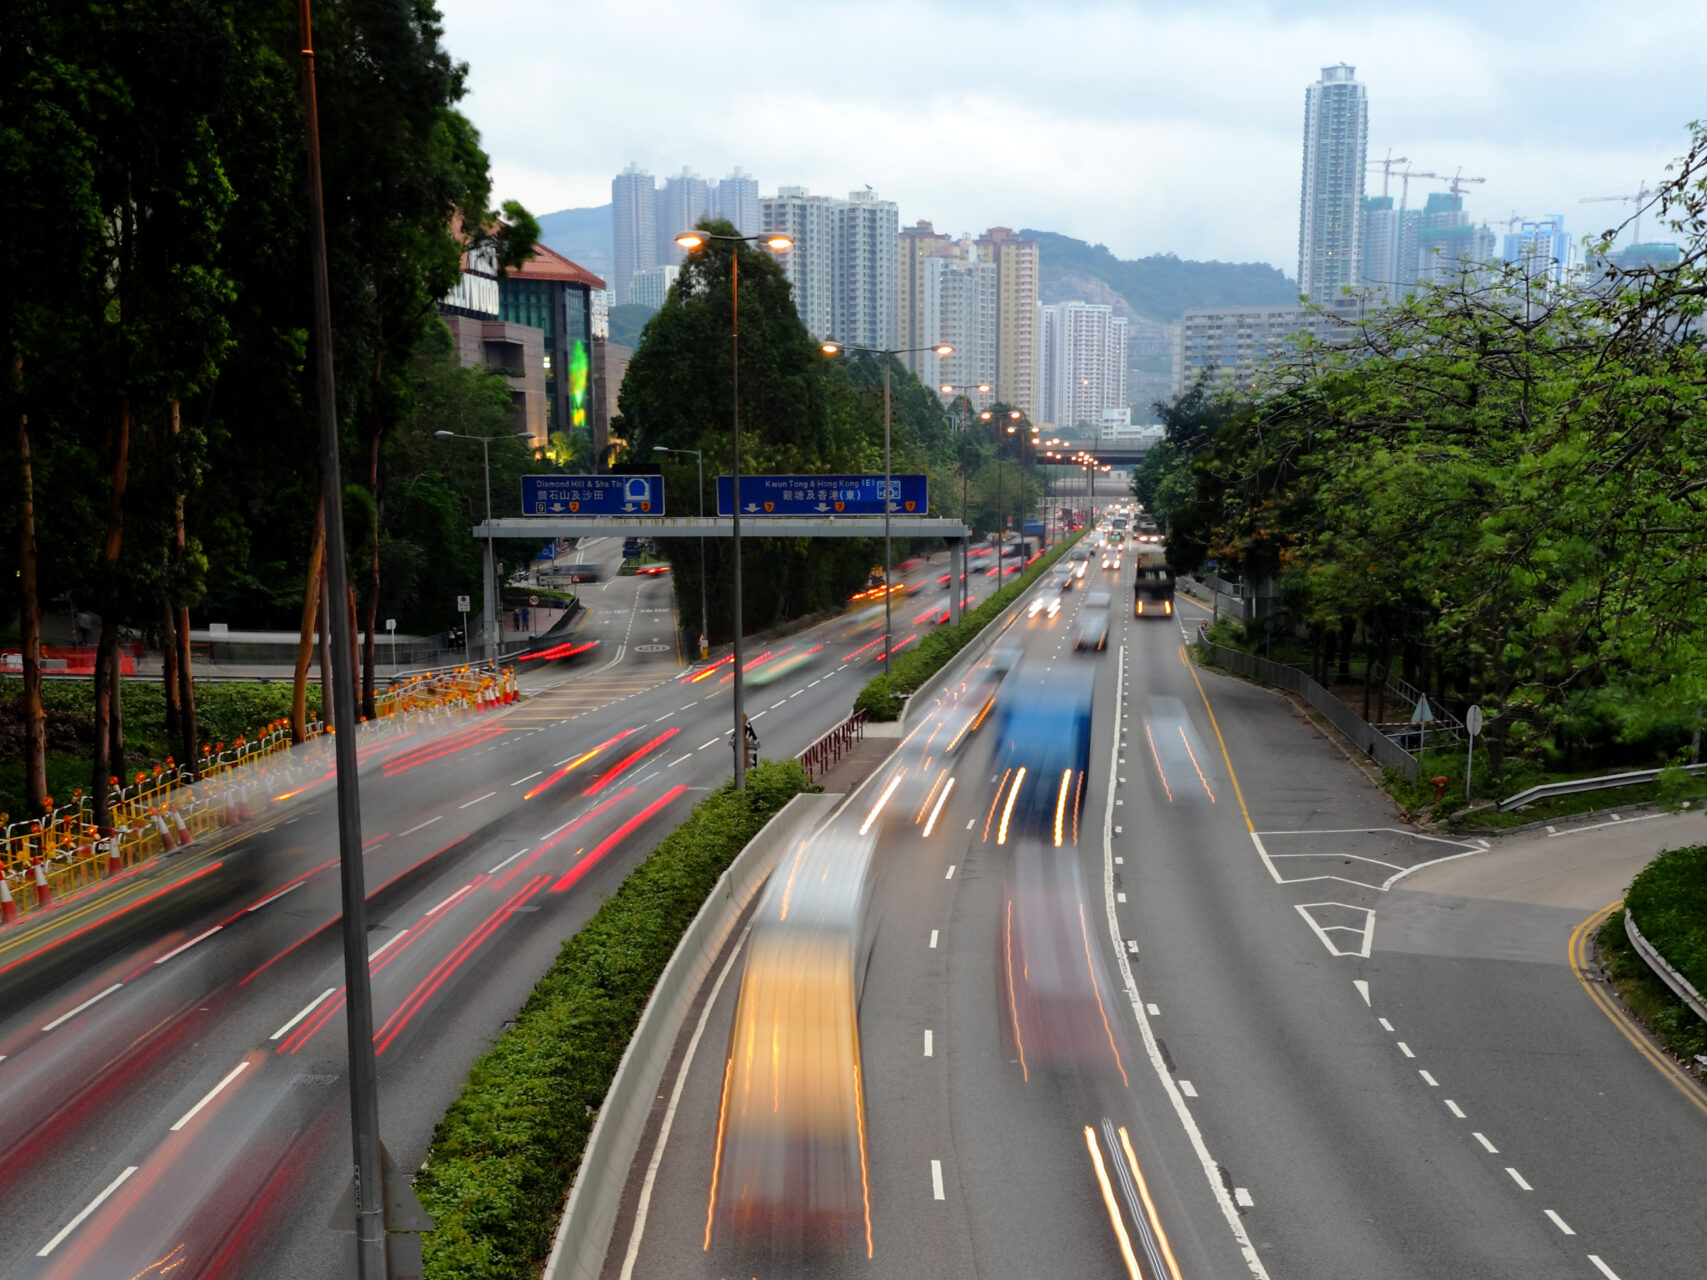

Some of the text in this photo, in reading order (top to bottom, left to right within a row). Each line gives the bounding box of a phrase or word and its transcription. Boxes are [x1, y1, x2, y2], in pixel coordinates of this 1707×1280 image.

[536, 480, 569, 488] Diamond
[571, 480, 585, 488] Hill
[587, 480, 593, 488] &
[595, 480, 609, 488] Sha
[765, 479, 875, 489] Kwun Tong & Hong Kong (E)
